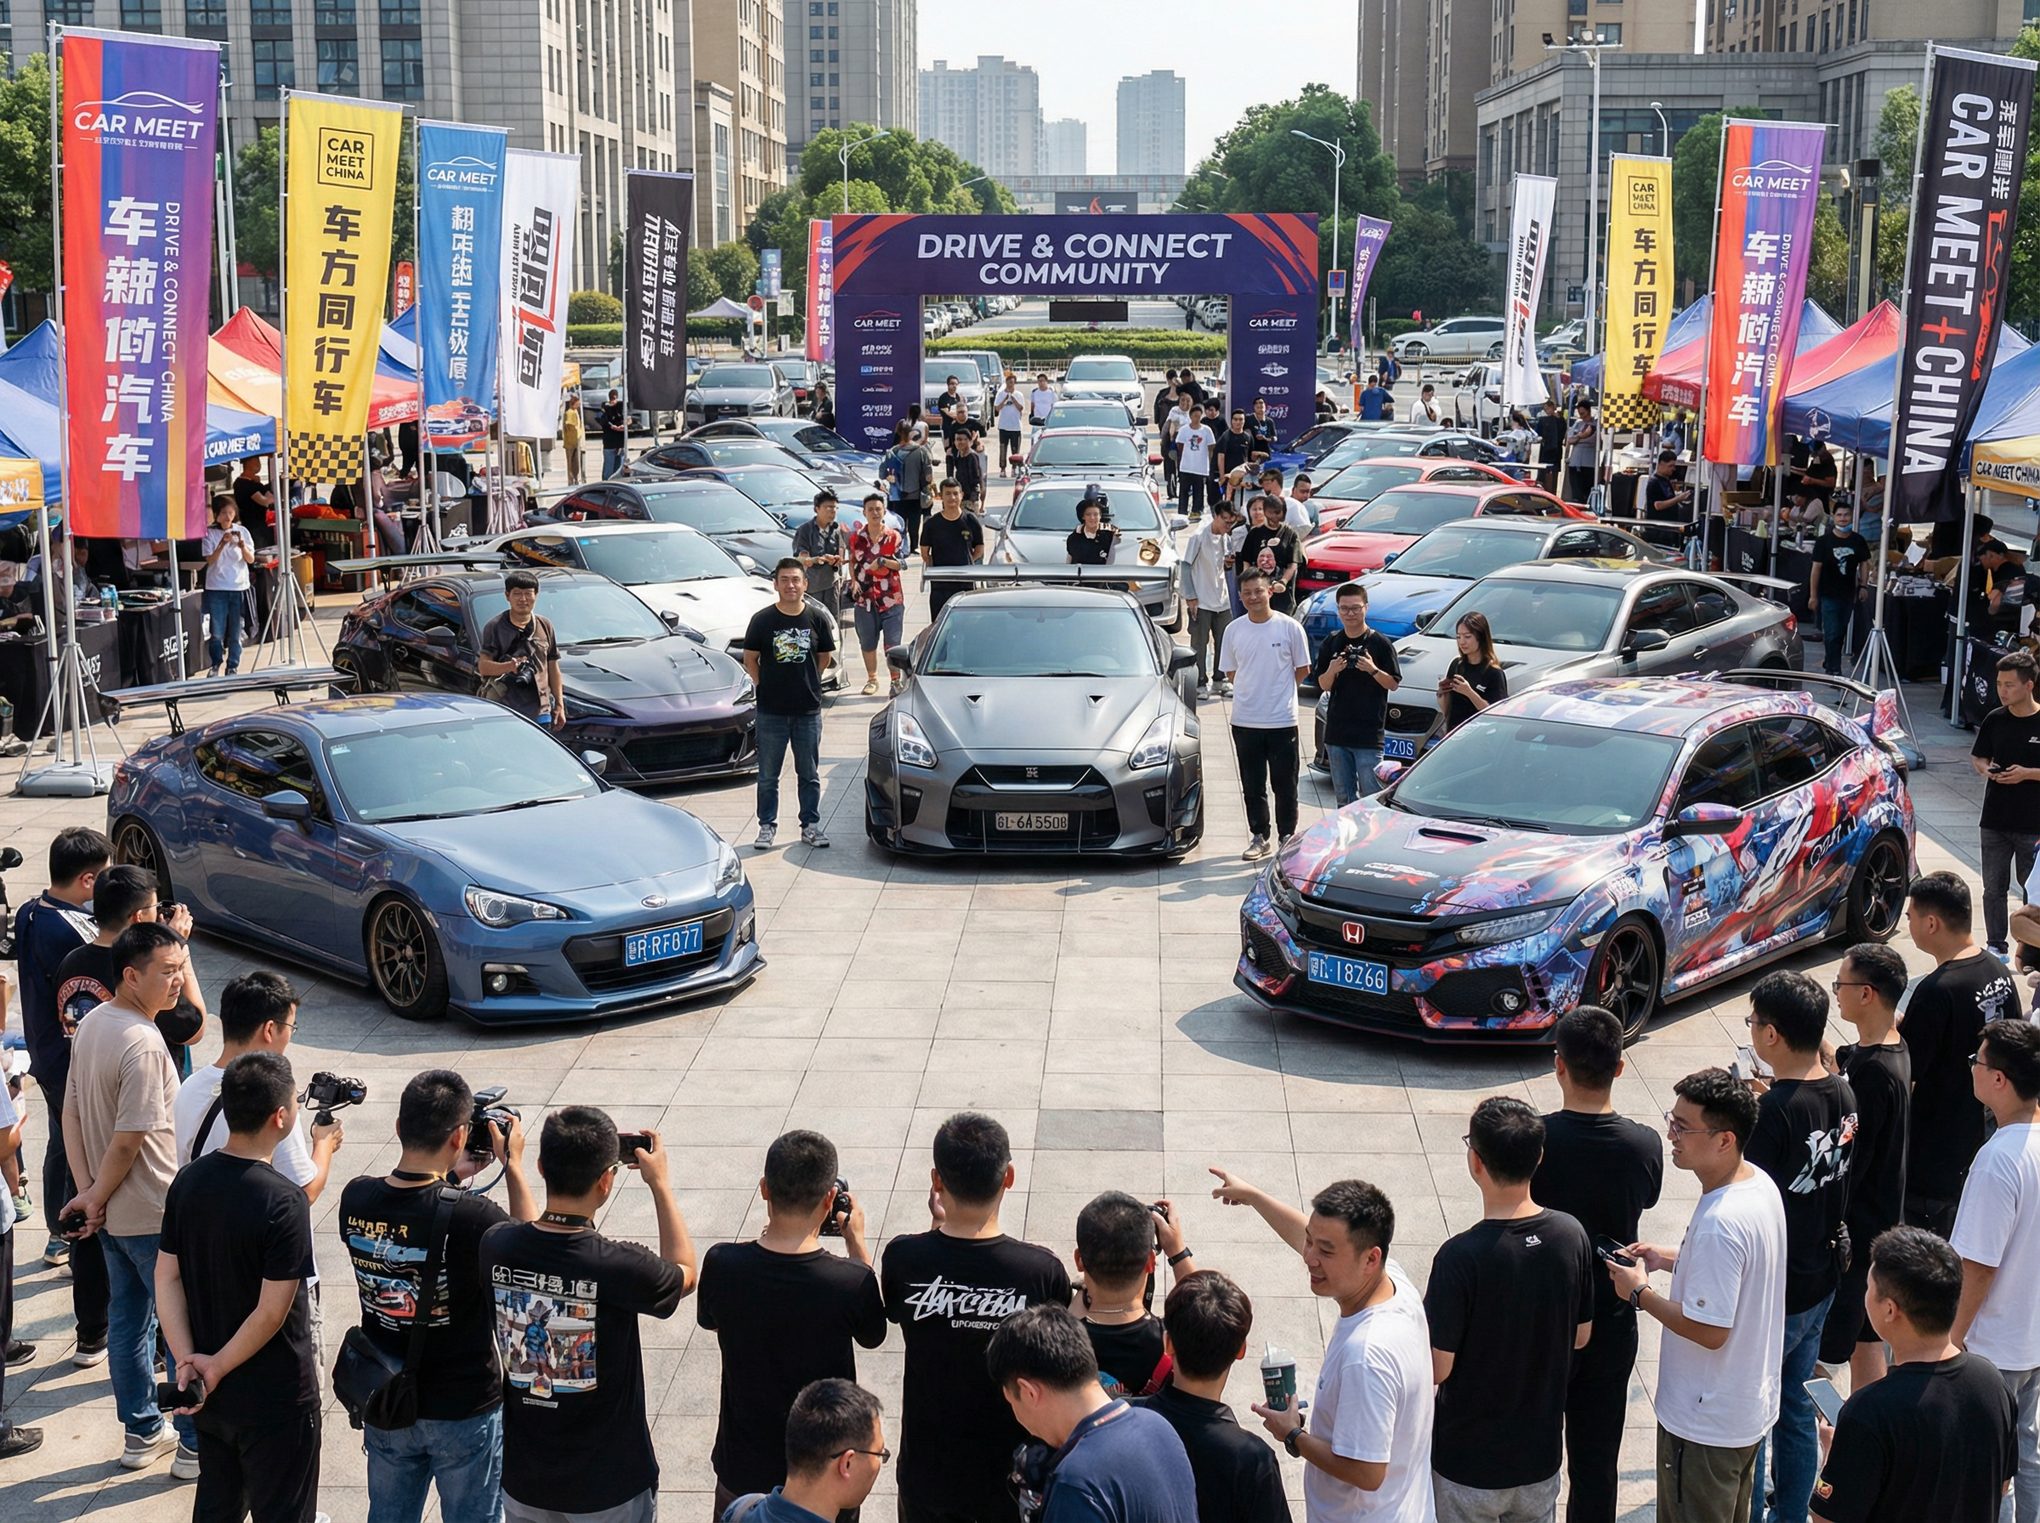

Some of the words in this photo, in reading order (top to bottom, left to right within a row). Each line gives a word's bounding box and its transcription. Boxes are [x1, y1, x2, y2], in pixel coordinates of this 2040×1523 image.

[74, 112, 127, 134] CAR
[134, 116, 205, 140] MEET
[1942, 93, 1994, 179] CAR
[327, 138, 365, 154] CAR
[326, 153, 365, 168] MEET
[326, 167, 365, 180] CHINA
[427, 168, 456, 182] CAR
[459, 171, 498, 186] MEET
[1732, 175, 1764, 189] CAR
[1767, 177, 1811, 191] MEET
[1633, 183, 1655, 192] CAR
[164, 202, 181, 257] DRIVE
[917, 233, 1023, 259] DRIVE
[1031, 233, 1054, 259] &
[1063, 233, 1233, 260] CONNECT
[163, 259, 179, 273] &
[978, 262, 1171, 285] COMMUNITY
[313, 204, 362, 416] 车方同行车
[1632, 228, 1657, 376] 车方同行车
[160, 277, 179, 364] CONNECT
[854, 319, 874, 328] CAR
[875, 319, 901, 328] MEET
[1249, 319, 1269, 327] CAR
[160, 370, 176, 423] CHINA
